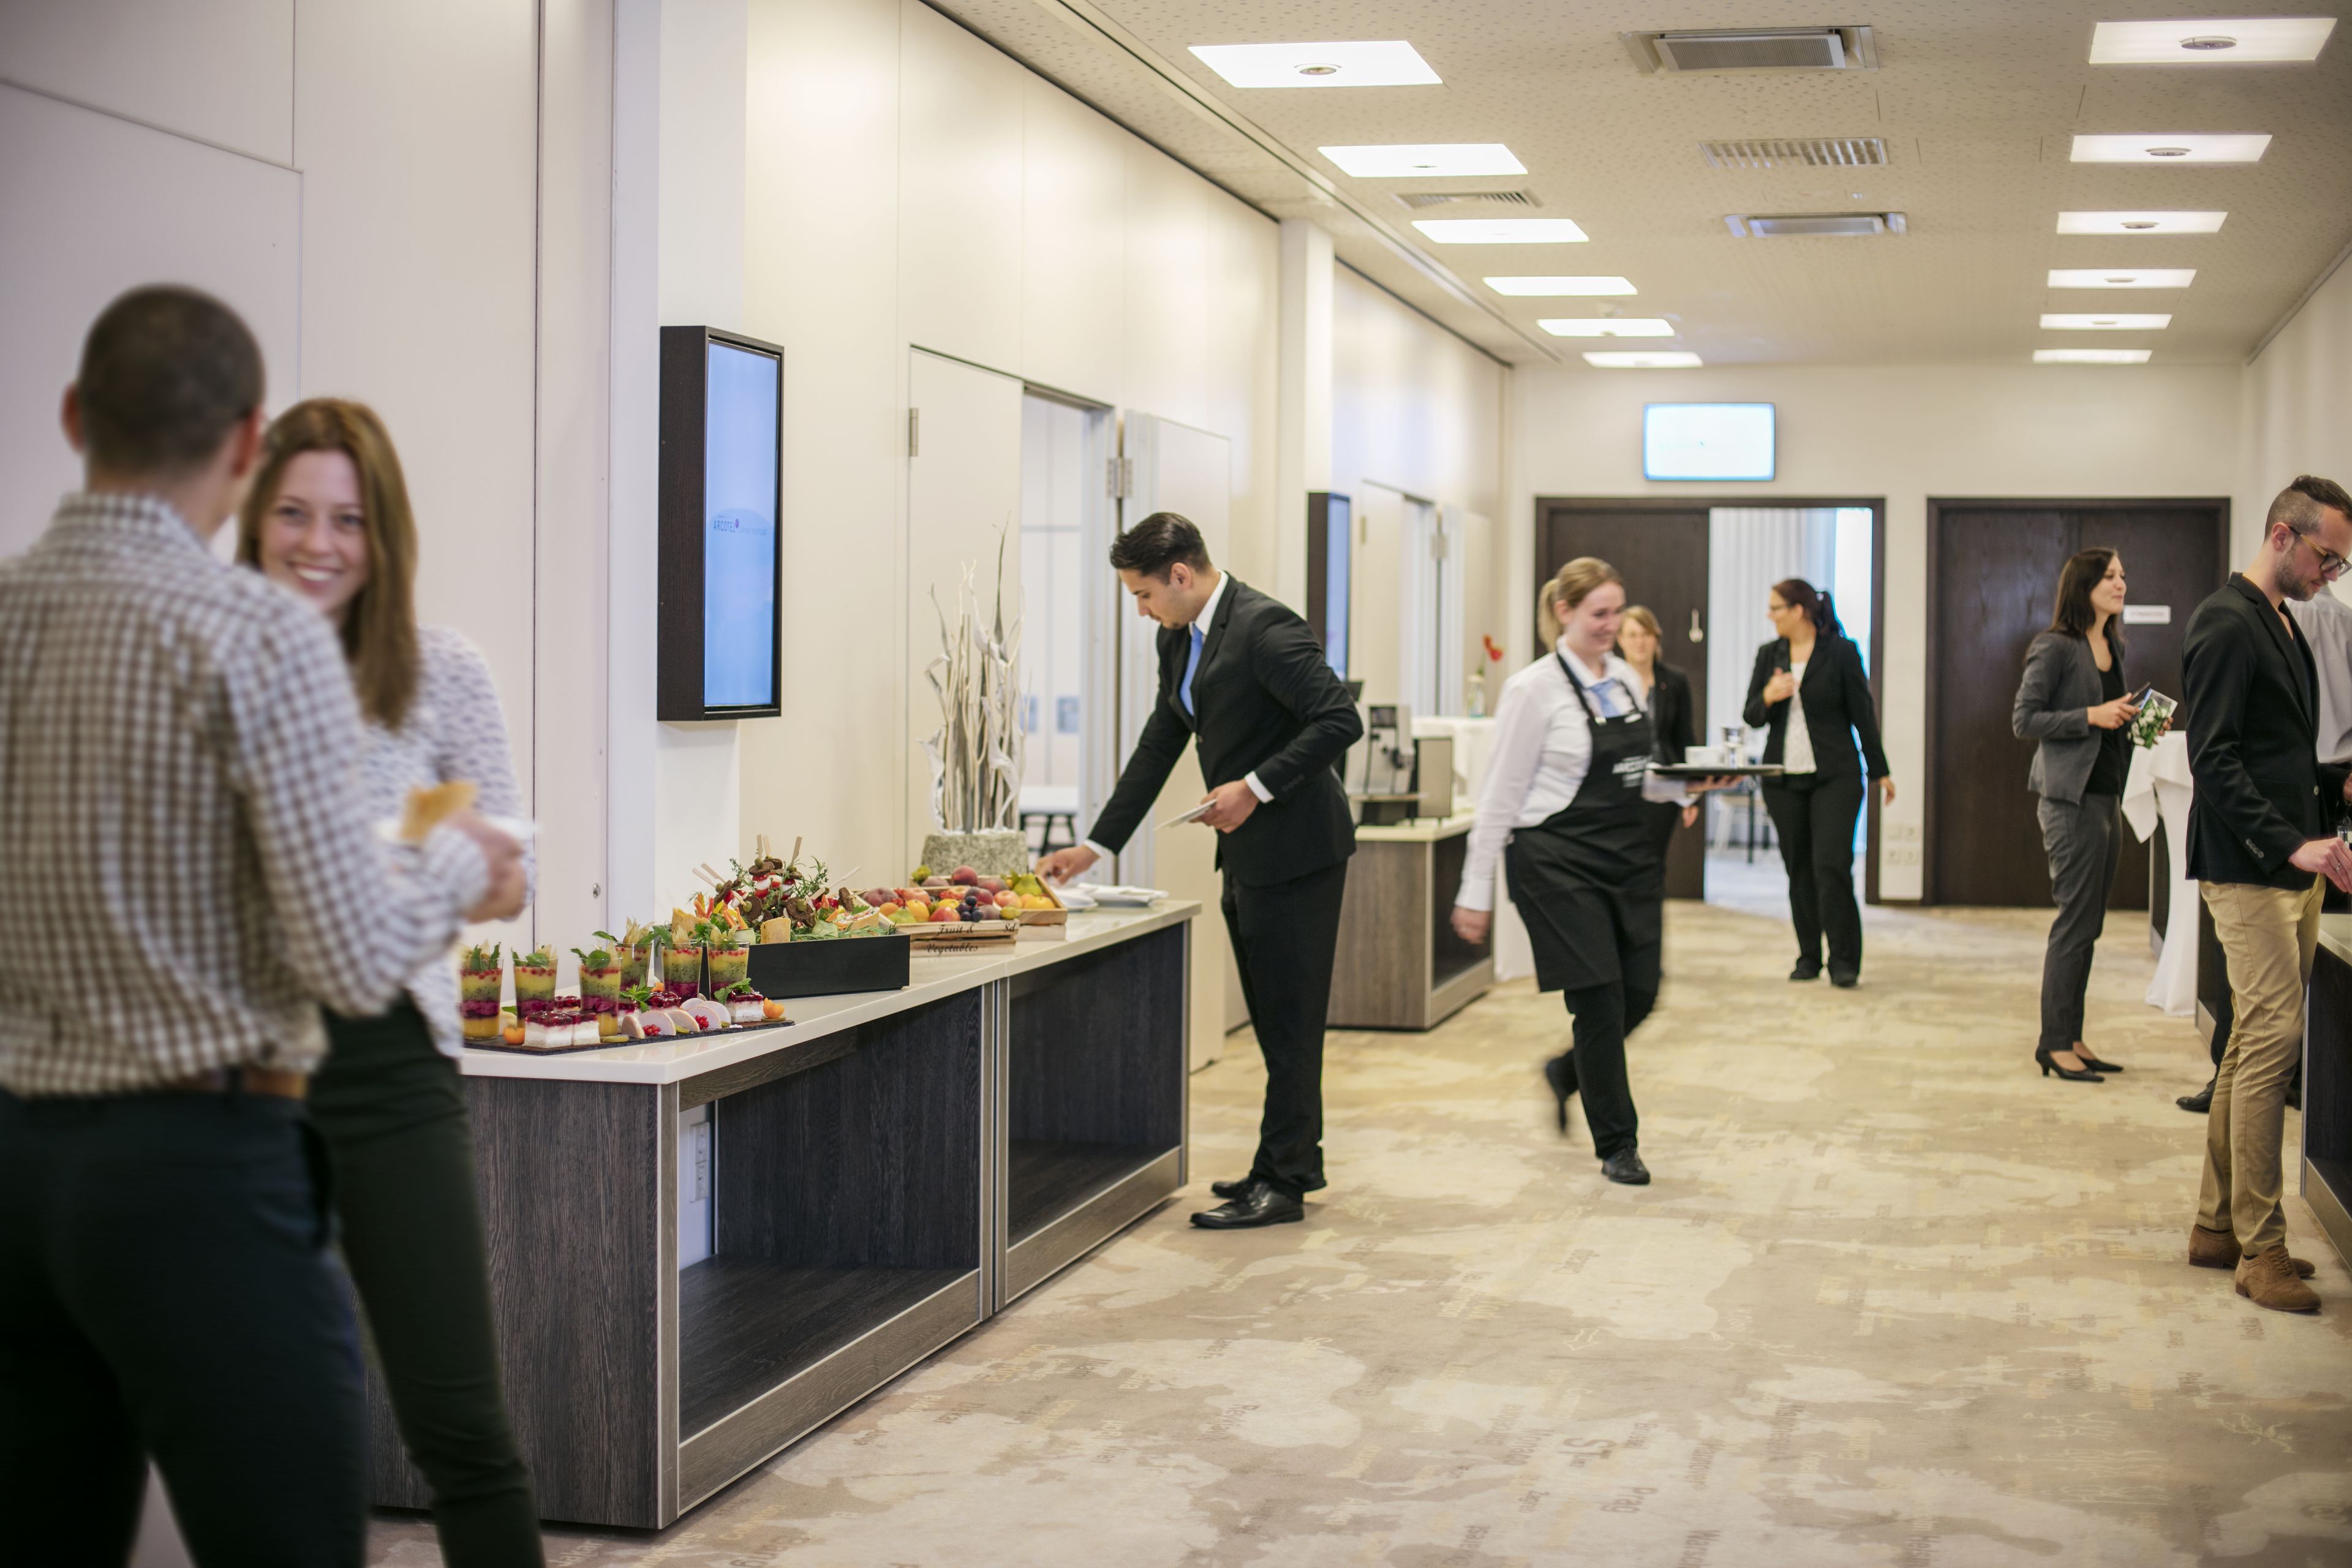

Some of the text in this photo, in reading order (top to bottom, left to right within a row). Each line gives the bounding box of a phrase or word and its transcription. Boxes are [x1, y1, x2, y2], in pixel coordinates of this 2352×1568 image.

[713, 519, 736, 533] ARCOTEL
[937, 924, 963, 936] Fruit
[926, 942, 978, 955] Vegetables
